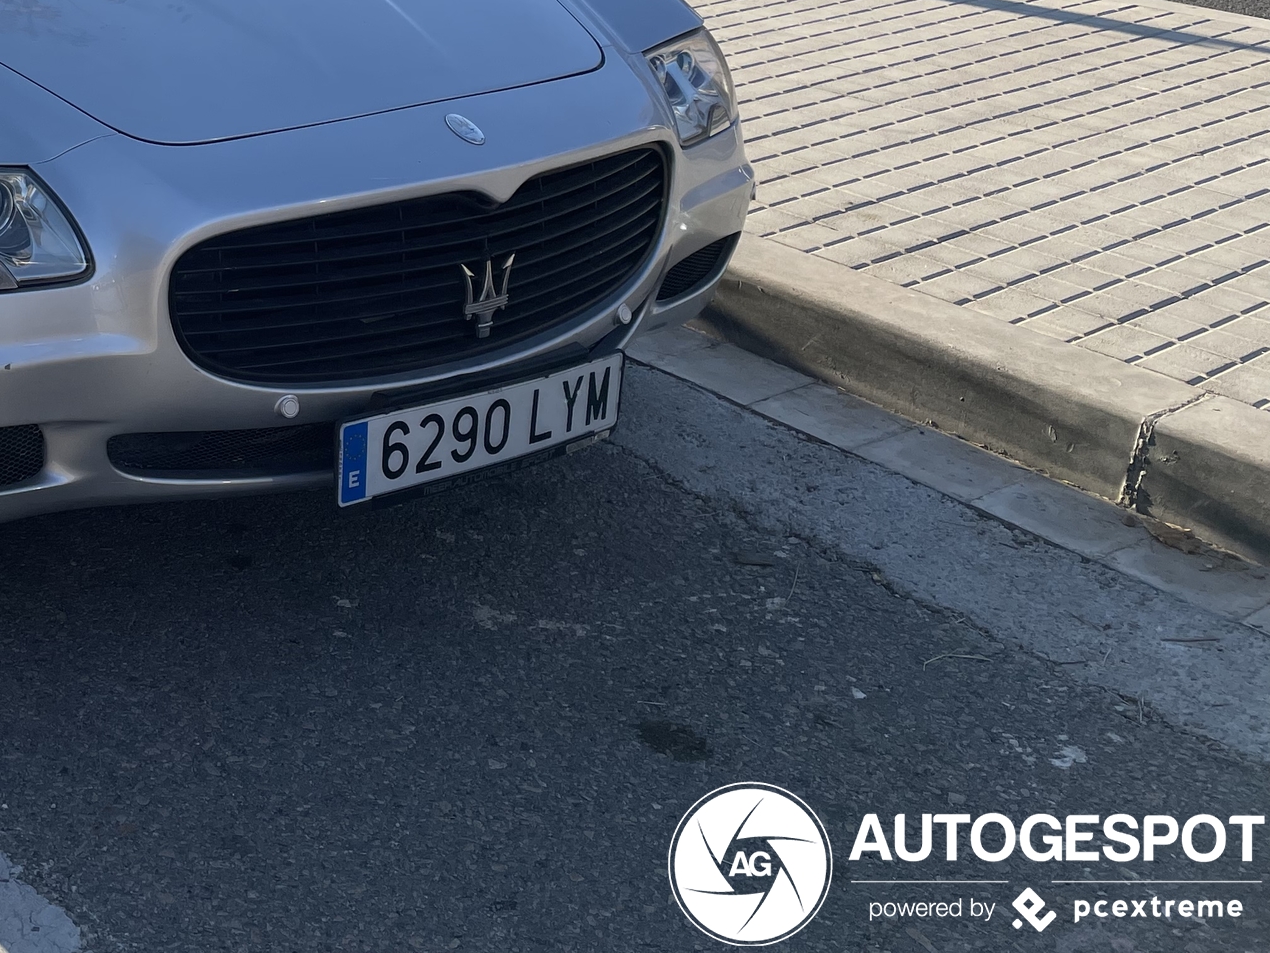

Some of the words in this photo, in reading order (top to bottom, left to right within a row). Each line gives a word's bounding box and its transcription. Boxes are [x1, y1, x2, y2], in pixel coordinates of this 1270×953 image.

[382, 398, 511, 480] 6290
[529, 366, 612, 445] LYM
[348, 470, 360, 488] E
